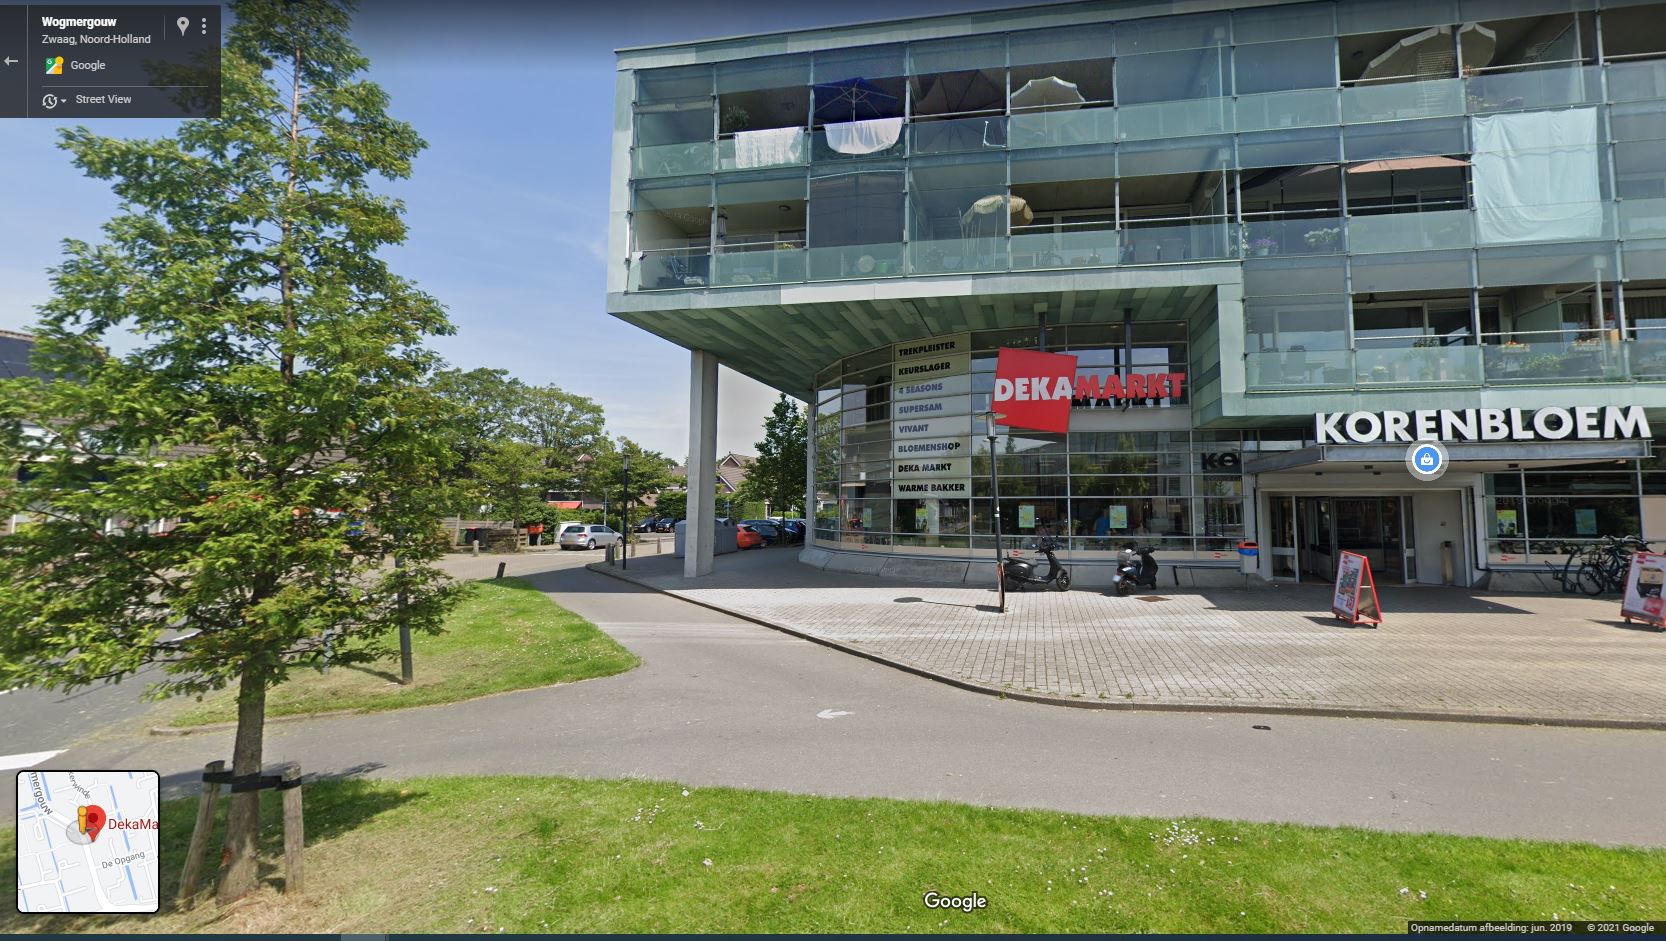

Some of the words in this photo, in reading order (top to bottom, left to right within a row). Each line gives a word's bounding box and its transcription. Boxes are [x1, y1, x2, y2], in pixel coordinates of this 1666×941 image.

[899, 341, 956, 357] TREKPLEISTER
[898, 362, 951, 376] KEURSLAGER
[906, 383, 943, 394] SEASONS
[994, 373, 1185, 402] DEKAMARKT
[899, 403, 943, 414] SUPERSAM
[899, 424, 929, 433] VIVANT
[1315, 405, 1652, 443] KORENBLOEM
[898, 442, 961, 453] BLOEMENSHOP
[898, 464, 920, 473] DEKA
[922, 463, 952, 472] MARKT
[898, 484, 929, 492] WARME
[930, 483, 966, 492] BAKKER
